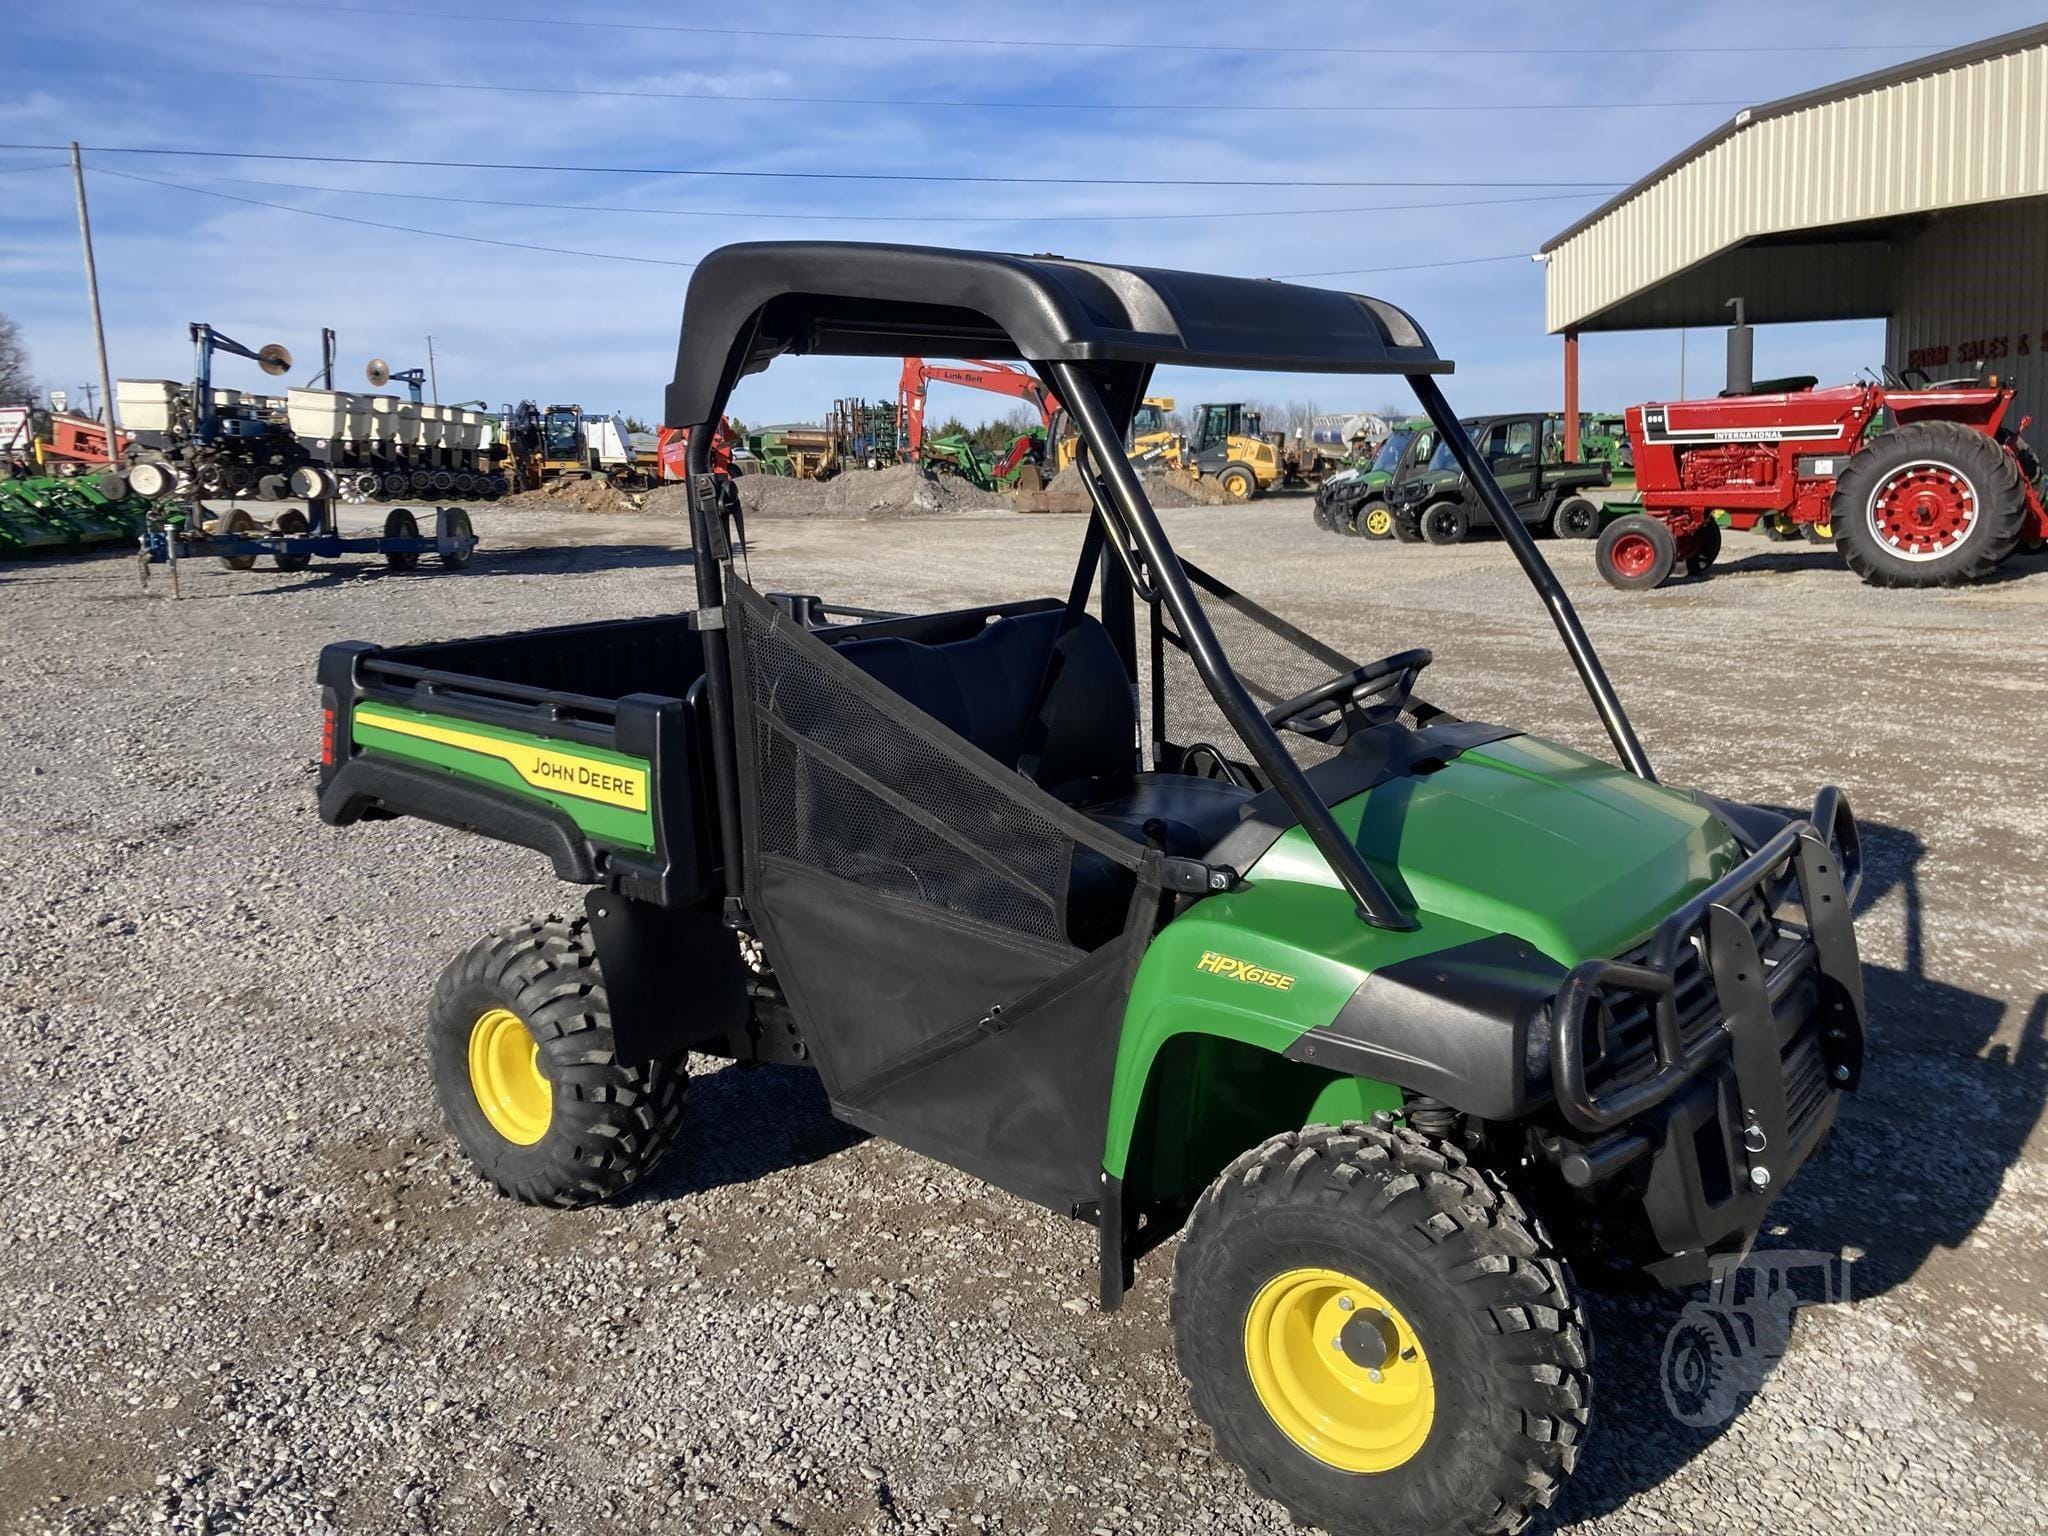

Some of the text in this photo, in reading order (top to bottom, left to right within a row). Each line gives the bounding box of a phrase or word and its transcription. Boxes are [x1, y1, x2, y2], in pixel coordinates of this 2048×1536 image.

[1908, 347, 1949, 368] FARM
[1957, 337, 2008, 364] SALES
[2018, 333, 2030, 355] &
[944, 371, 983, 383] Link-Belt
[1714, 431, 1782, 440] INTERNATIONAL
[532, 757, 634, 796] JOHN DEERE
[1196, 951, 1296, 991] HPX615E
